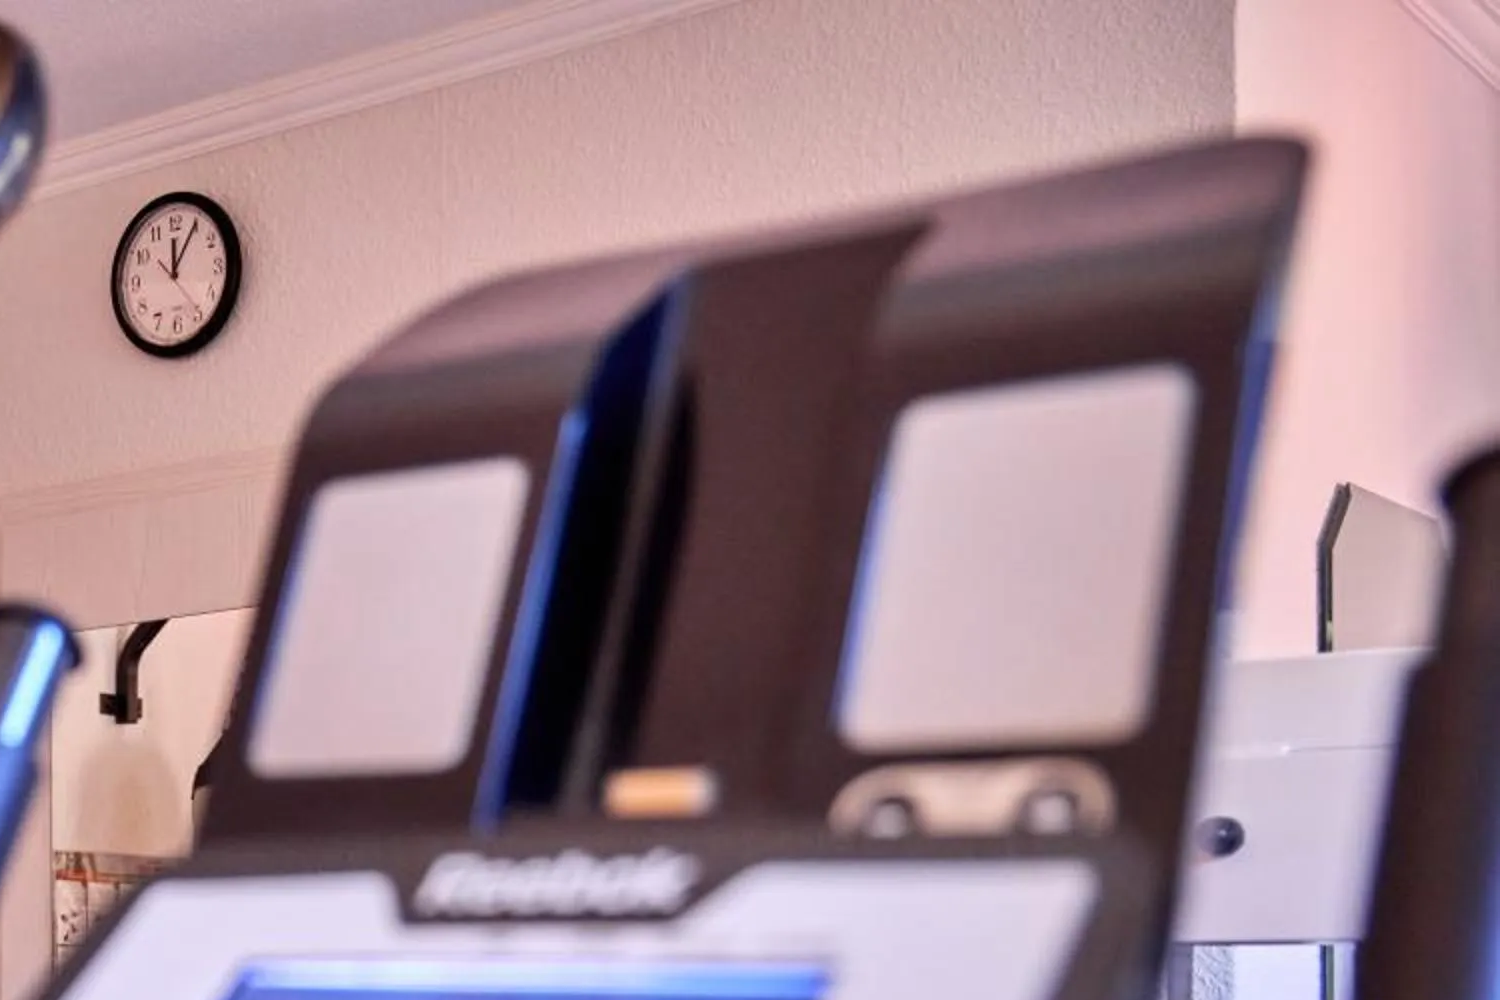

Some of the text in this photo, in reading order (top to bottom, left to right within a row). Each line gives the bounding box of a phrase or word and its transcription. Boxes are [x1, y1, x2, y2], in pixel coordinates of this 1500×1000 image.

[168, 214, 183, 233] 12
[150, 225, 162, 243] 11
[206, 231, 216, 249] 2
[136, 248, 151, 265] 10
[213, 257, 224, 275] 3
[131, 274, 141, 292] 9
[136, 298, 148, 314] 8
[193, 305, 203, 323] 5
[152, 311, 163, 331] 7
[173, 315, 183, 334] 6
